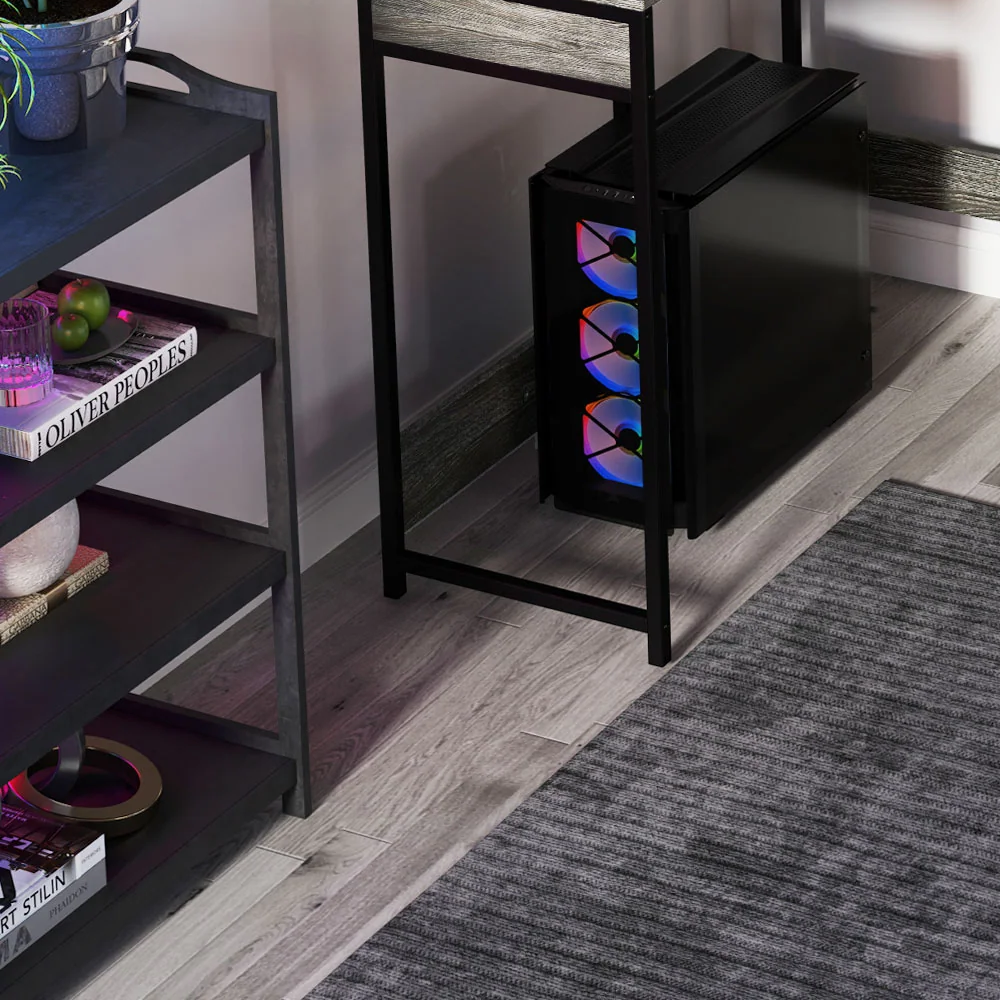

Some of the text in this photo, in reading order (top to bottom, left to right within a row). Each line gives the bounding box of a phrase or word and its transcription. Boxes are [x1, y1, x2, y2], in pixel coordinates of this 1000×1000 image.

[46, 340, 187, 448] OLIVER PEOPLES
[0, 870, 66, 935] RT STILIN
[49, 882, 88, 919] PHAIDON
